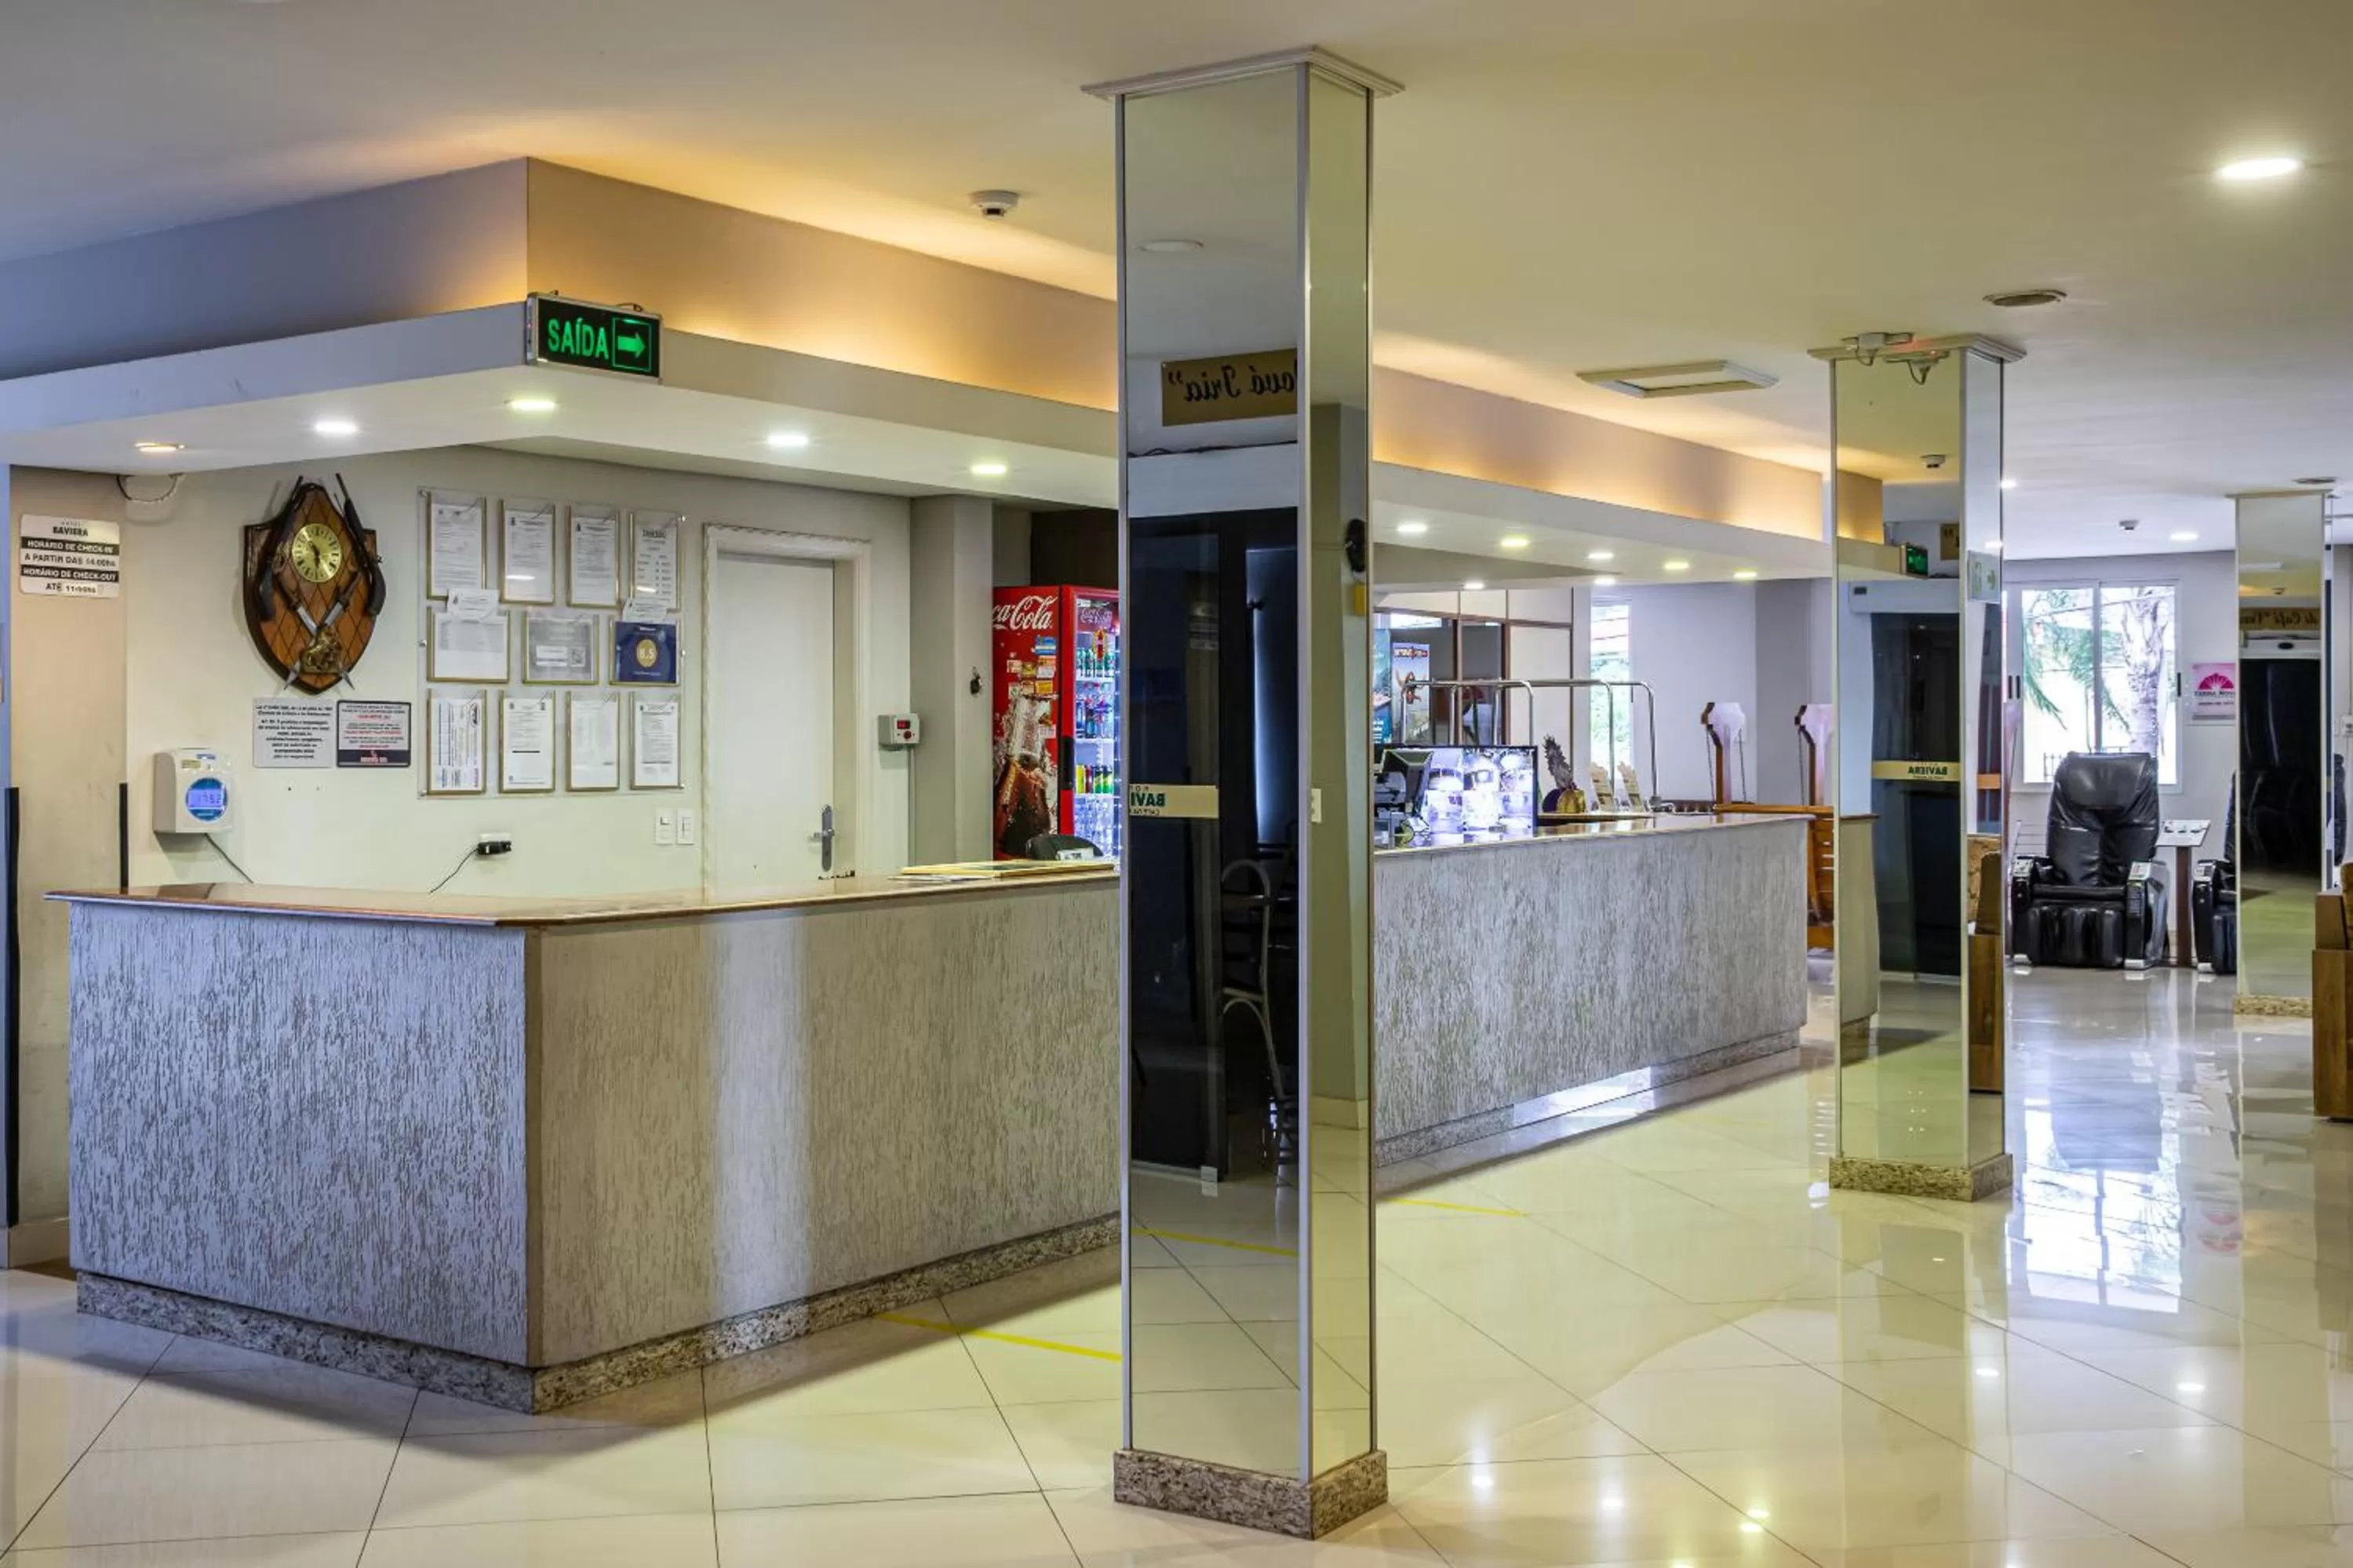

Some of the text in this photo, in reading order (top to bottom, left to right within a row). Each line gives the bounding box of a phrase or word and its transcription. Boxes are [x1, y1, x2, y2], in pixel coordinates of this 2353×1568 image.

[548, 318, 610, 361] SAÍDA
[65, 556, 83, 565] DAS
[993, 595, 1058, 630] ca-Cola
